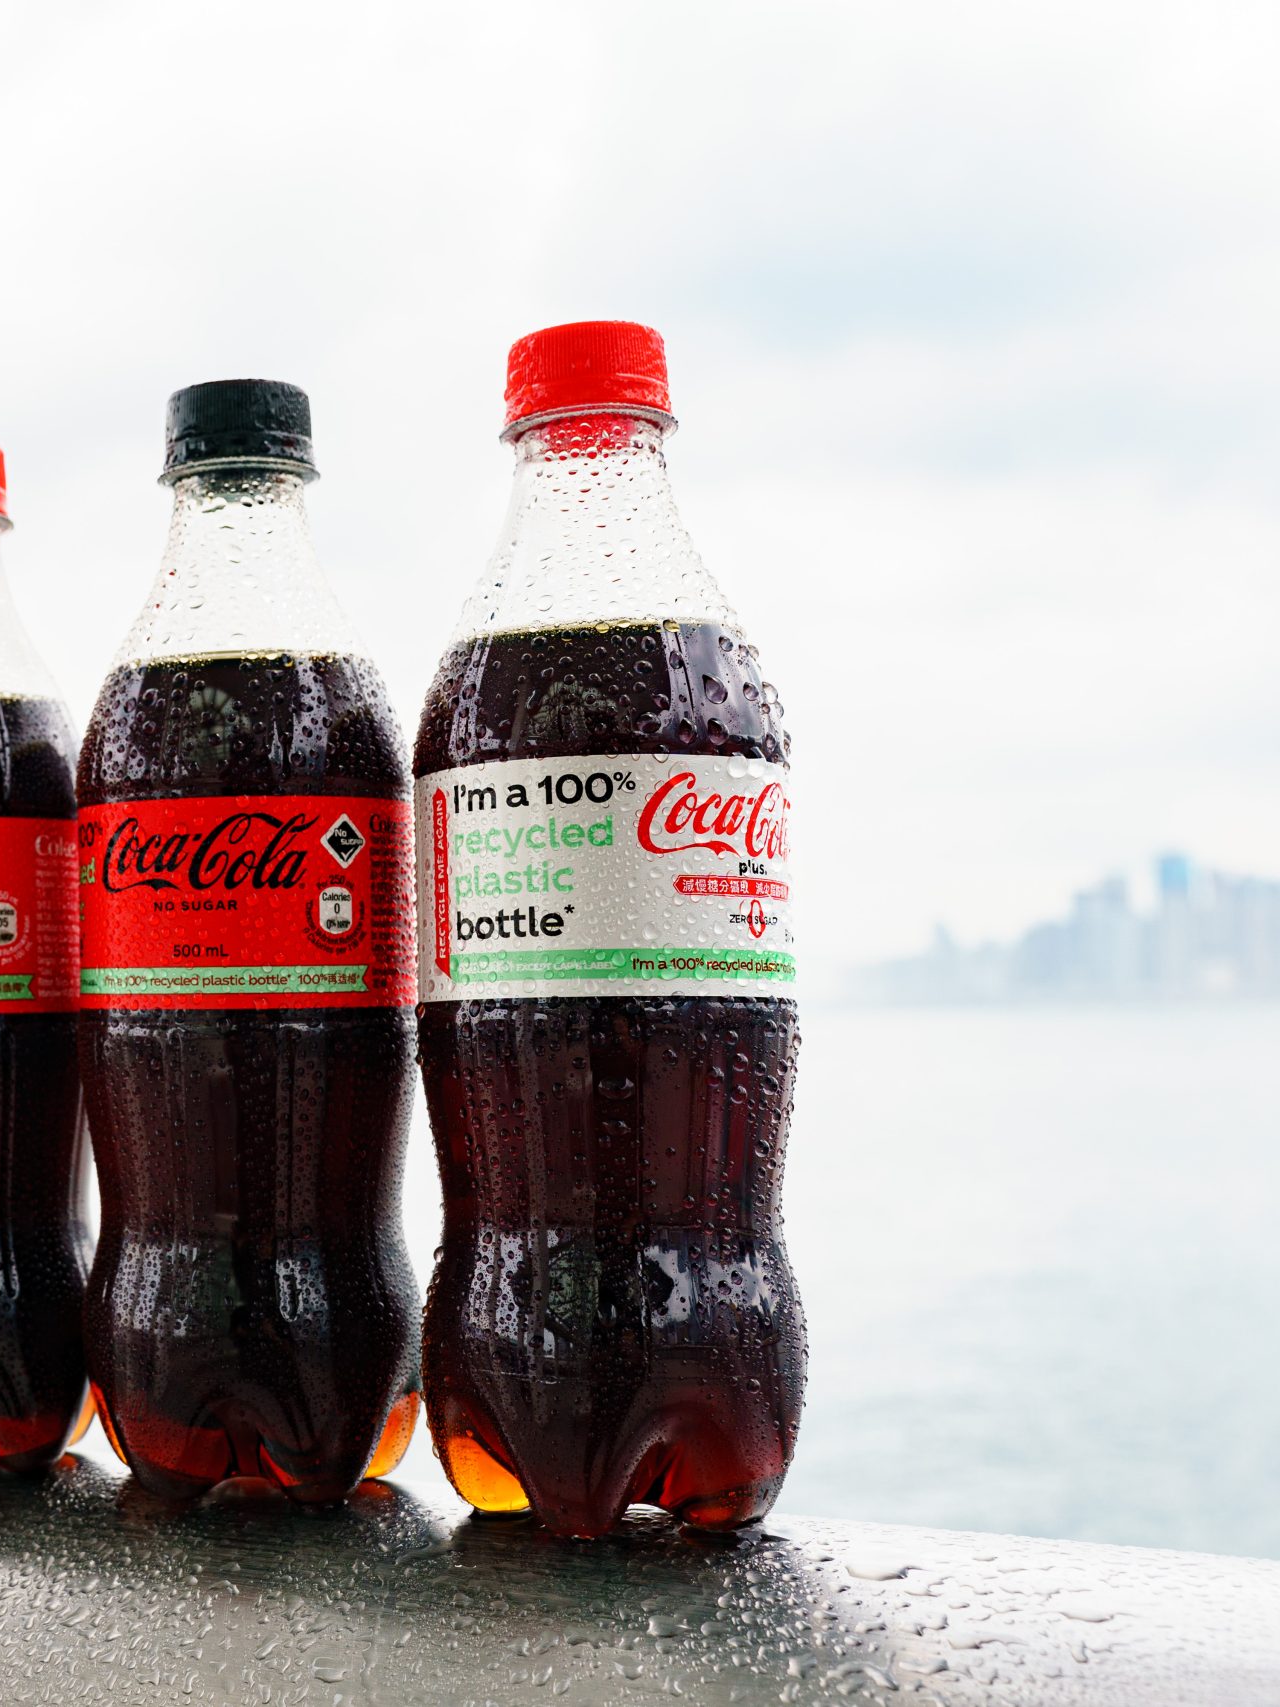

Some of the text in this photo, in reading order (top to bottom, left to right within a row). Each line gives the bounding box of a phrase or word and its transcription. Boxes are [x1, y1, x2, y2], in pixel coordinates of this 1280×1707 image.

[453, 771, 636, 814] I'm a 100%
[334, 828, 347, 837] No
[435, 800, 444, 850] AGAIN
[455, 815, 613, 858] recycled
[102, 813, 318, 893] Coca-Cola
[436, 853, 445, 879] ME
[455, 860, 574, 904] plastic
[321, 892, 350, 902] Calories
[153, 900, 238, 912] NO SUGAR
[334, 903, 340, 914] 0
[173, 944, 229, 958] 500 mL
[632, 957, 654, 971] I'm
[657, 960, 668, 970] a
[670, 957, 704, 971] 100%
[706, 959, 753, 972] recycled
[150, 975, 199, 988] recycled
[202, 974, 246, 988] plastic
